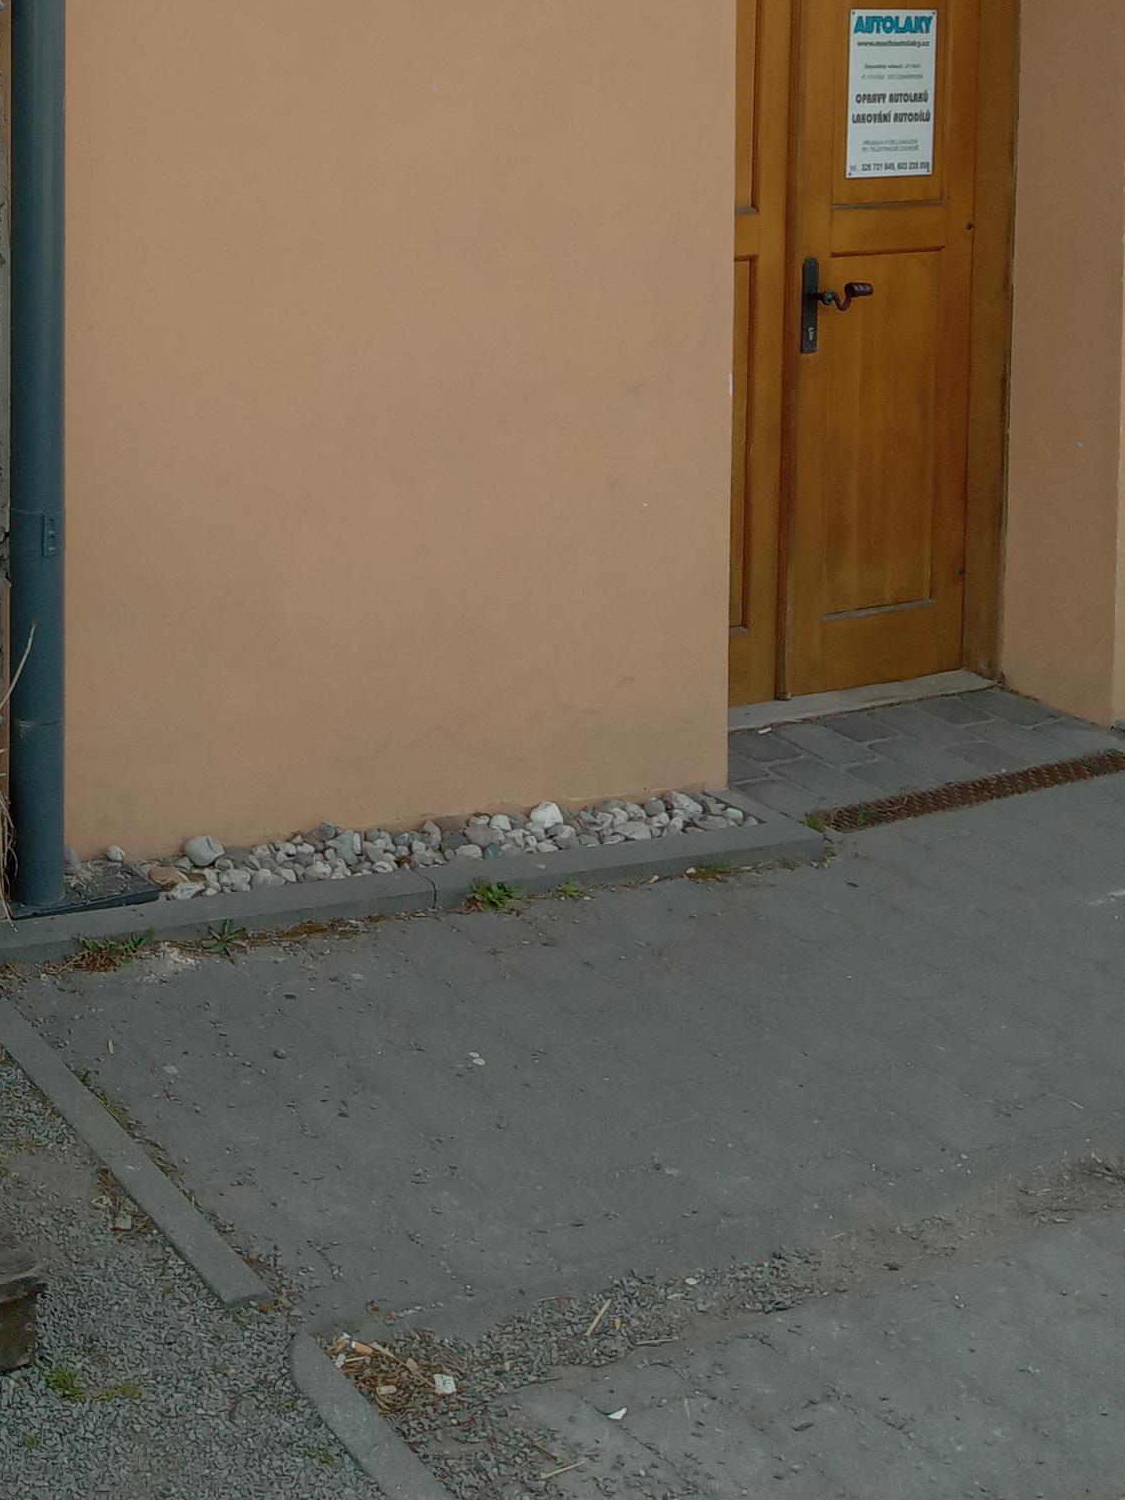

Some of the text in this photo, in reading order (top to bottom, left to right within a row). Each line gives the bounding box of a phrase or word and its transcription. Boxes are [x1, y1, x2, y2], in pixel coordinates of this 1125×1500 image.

[853, 15, 933, 34] AUTOLAKY
[855, 88, 929, 104] OPRAVY AUTOLAKŮ
[851, 109, 892, 124] LAKOVÁNÍ
